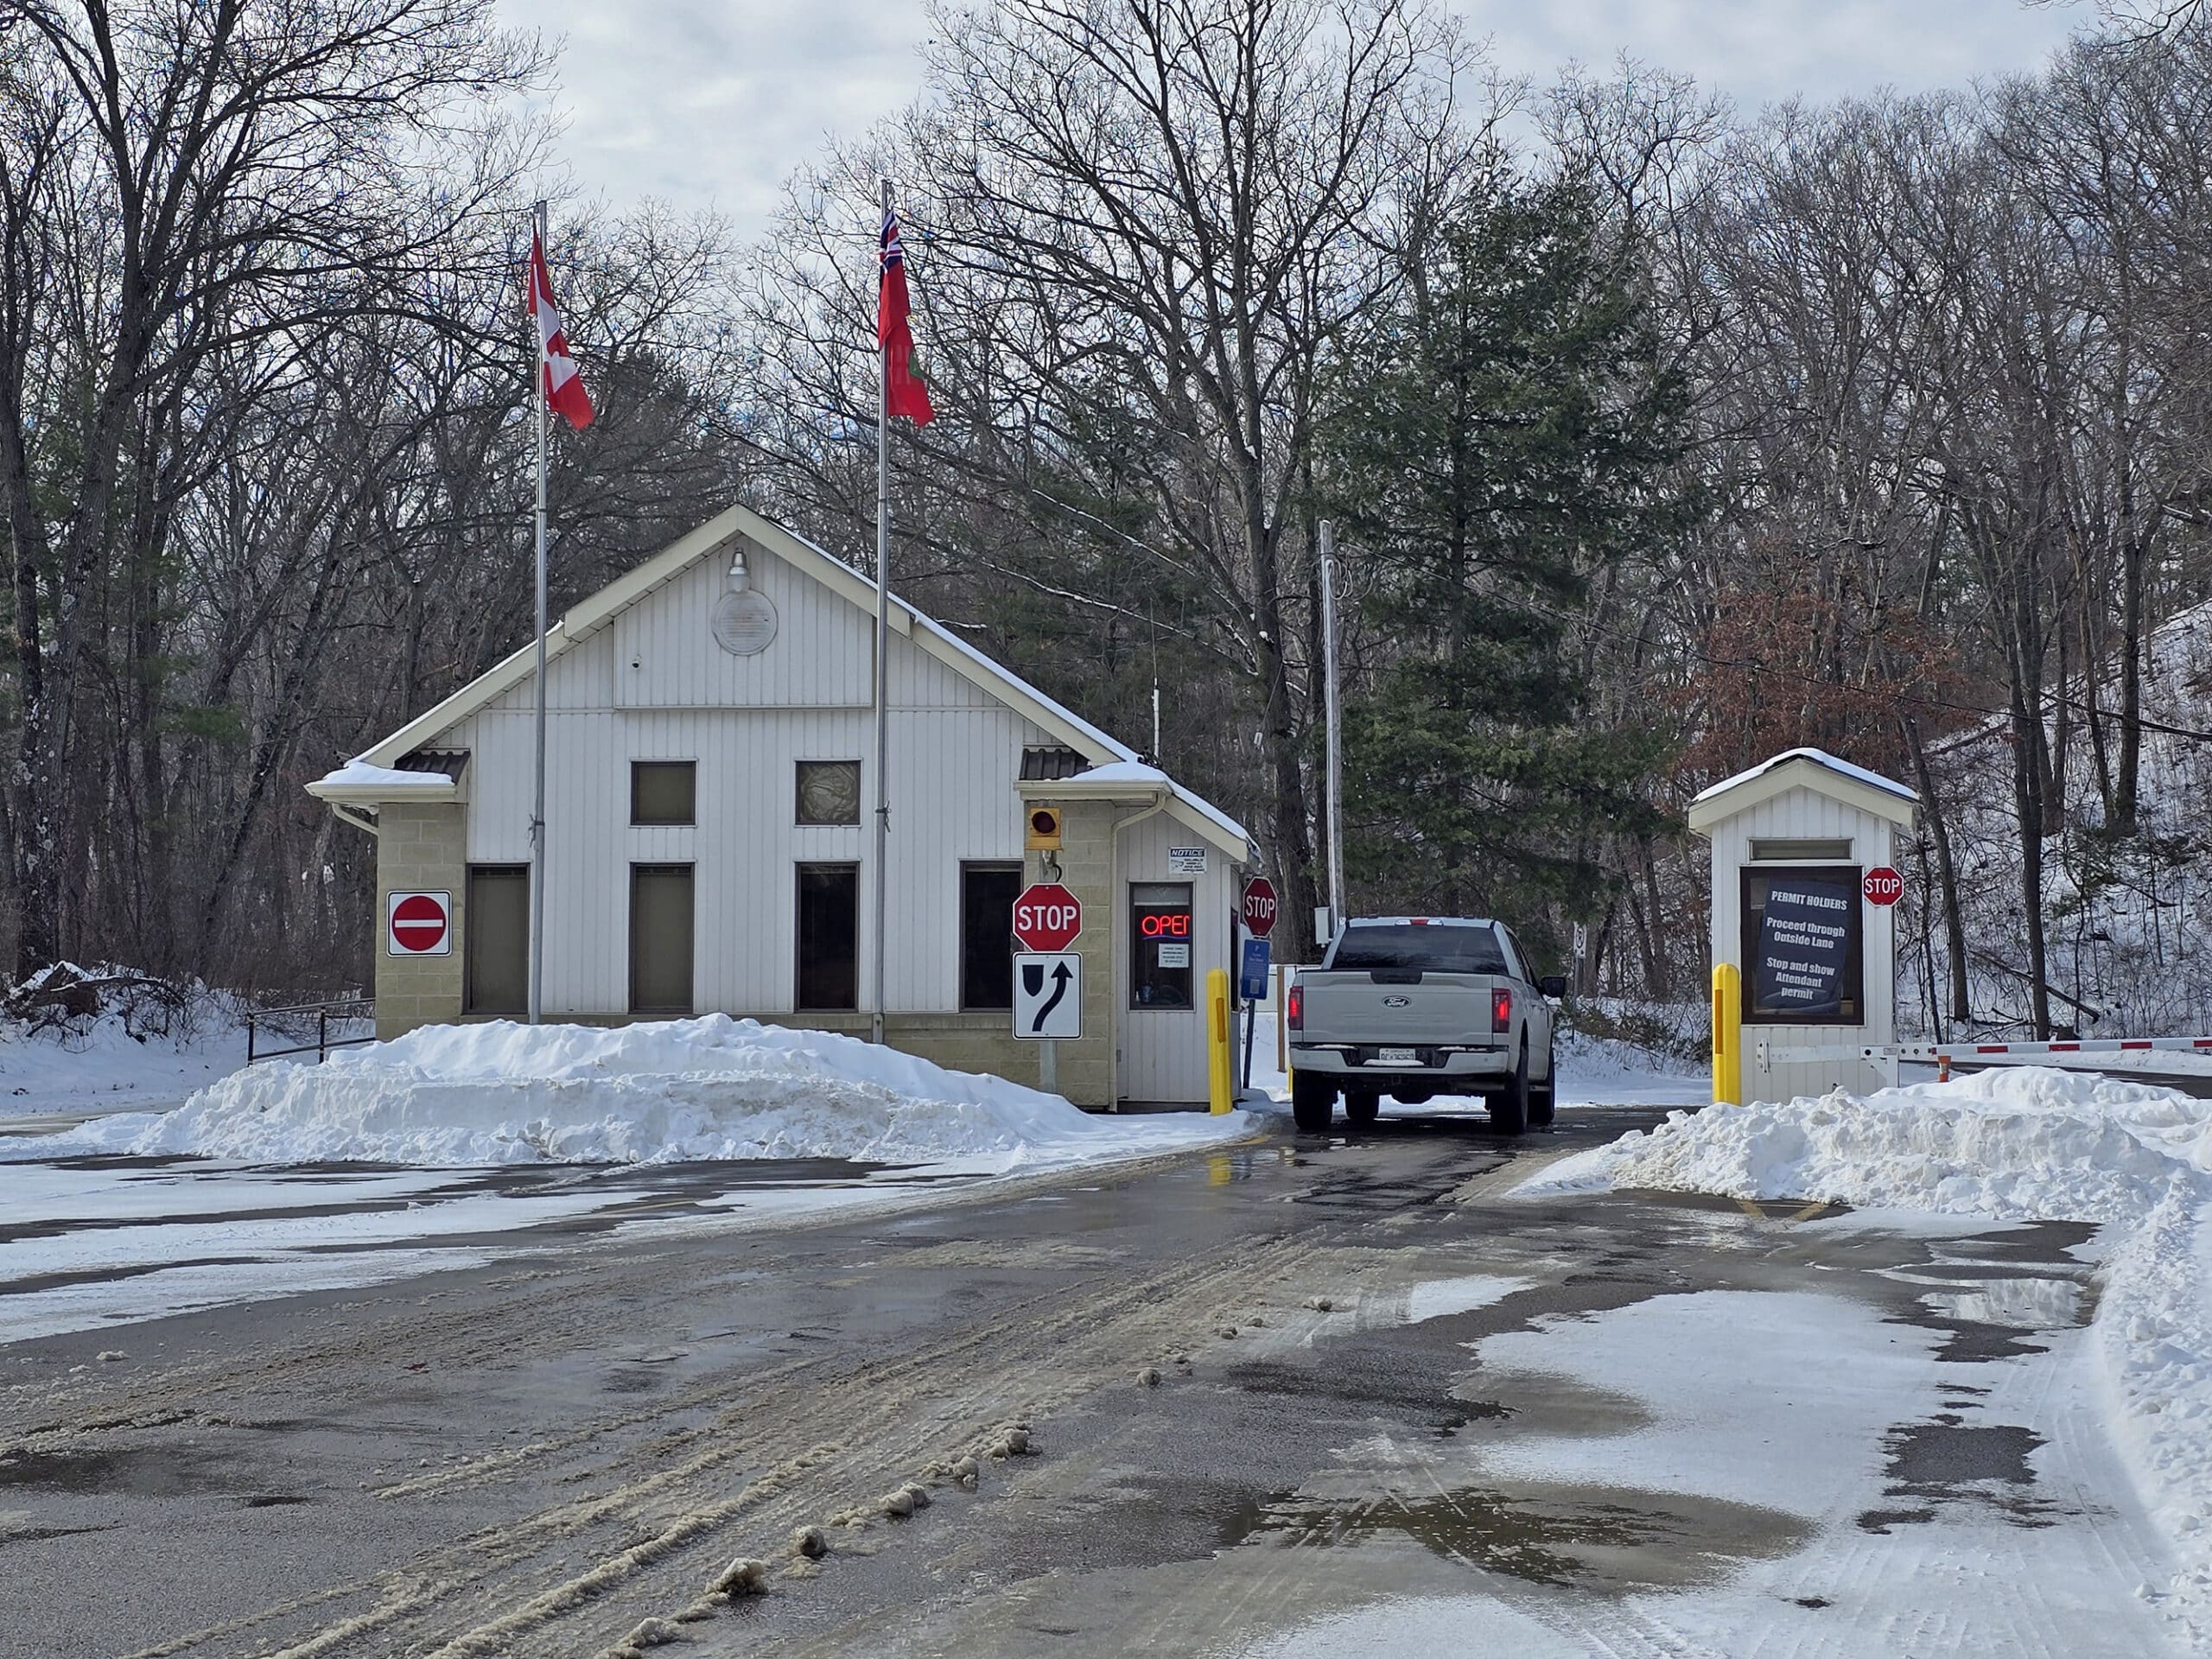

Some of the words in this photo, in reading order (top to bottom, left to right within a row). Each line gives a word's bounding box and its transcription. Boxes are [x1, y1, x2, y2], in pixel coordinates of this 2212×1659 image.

[1865, 878, 1900, 894] STOP
[1246, 895, 1275, 920] STOP
[1771, 890, 1806, 906] PERMIT
[1807, 893, 1847, 911] HOLDERS
[1018, 905, 1077, 931] STOP
[1766, 917, 1806, 931] Proceed
[1807, 922, 1846, 938] through
[1774, 931, 1810, 946] Outside
[1812, 936, 1834, 950] Lane
[1766, 957, 1789, 970] Stop
[1789, 961, 1808, 973] and
[1809, 963, 1835, 976] show
[1776, 972, 1822, 988] Attendant
[1781, 987, 1814, 1001] permit
